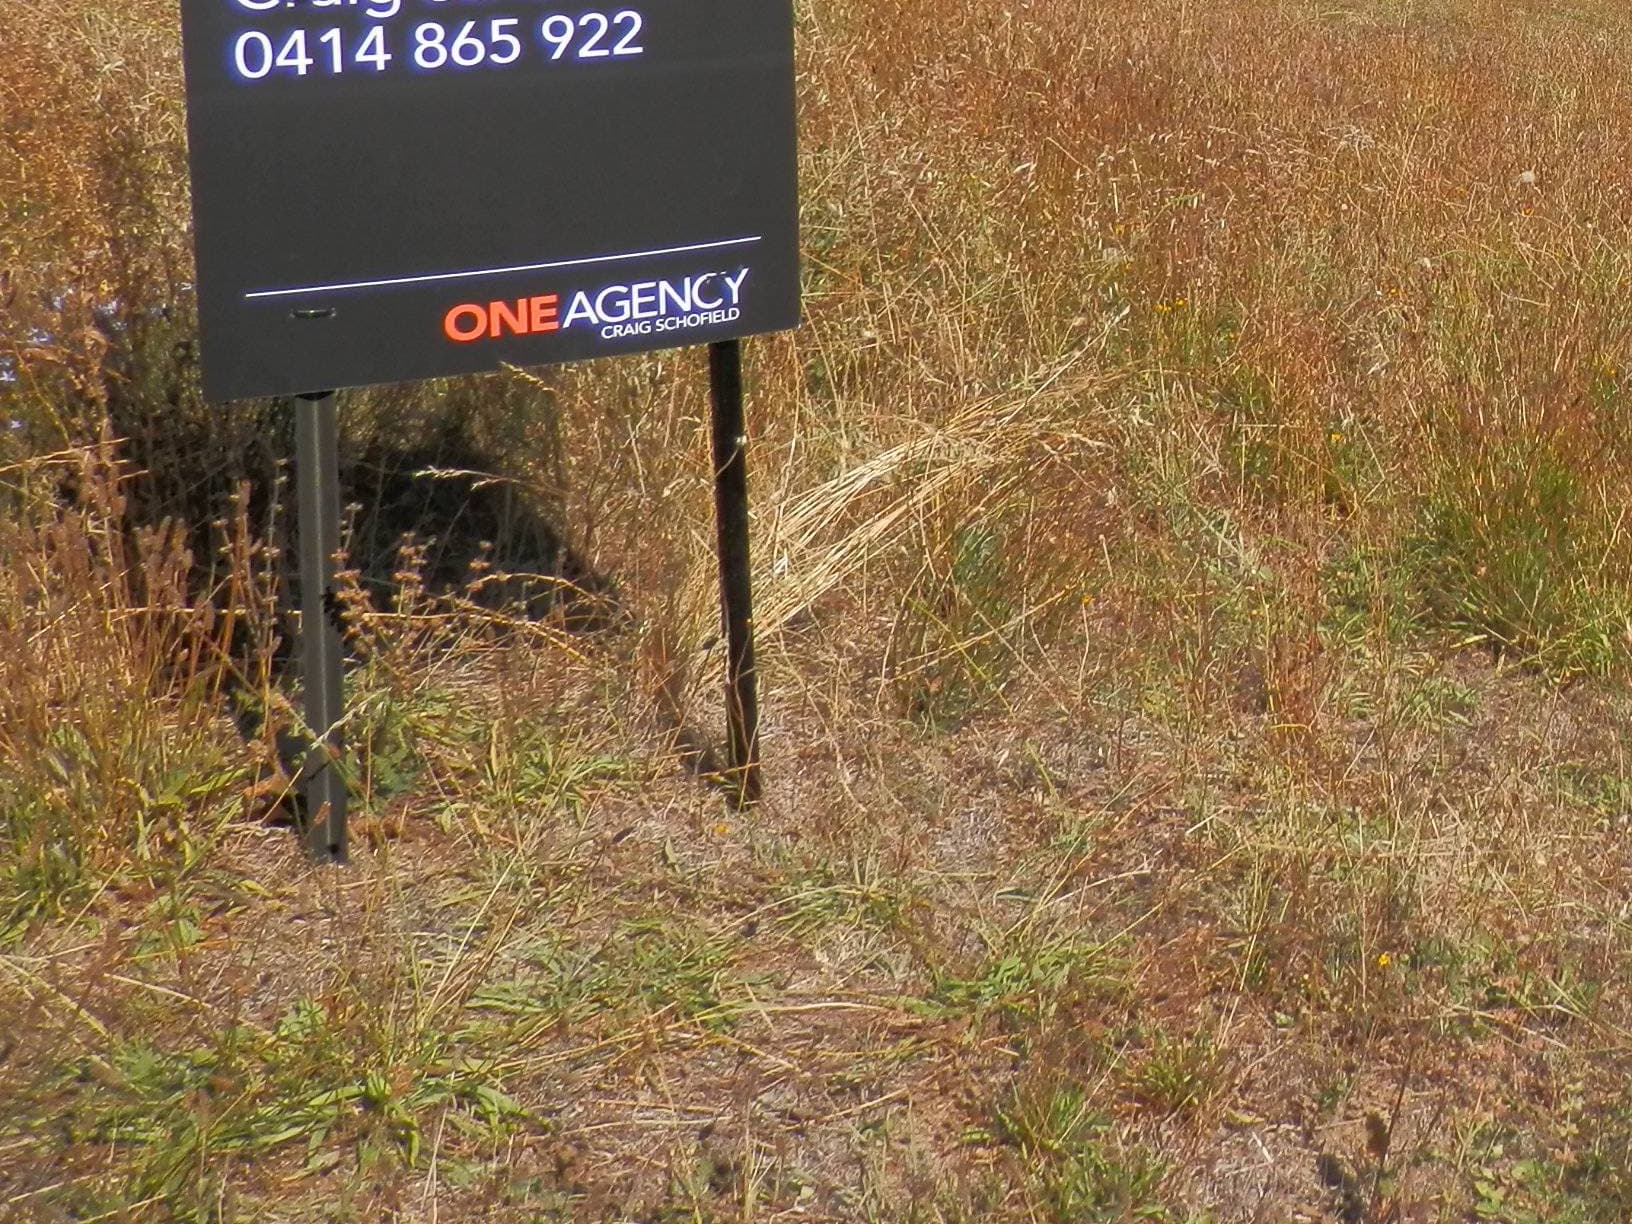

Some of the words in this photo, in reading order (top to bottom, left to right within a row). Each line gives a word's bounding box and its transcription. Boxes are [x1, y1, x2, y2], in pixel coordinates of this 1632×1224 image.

[234, 25, 392, 78] 0414
[413, 18, 522, 69] 865
[541, 10, 644, 60] 922
[600, 322, 652, 341] CRAIG
[655, 306, 741, 332] SCHOFIELD
